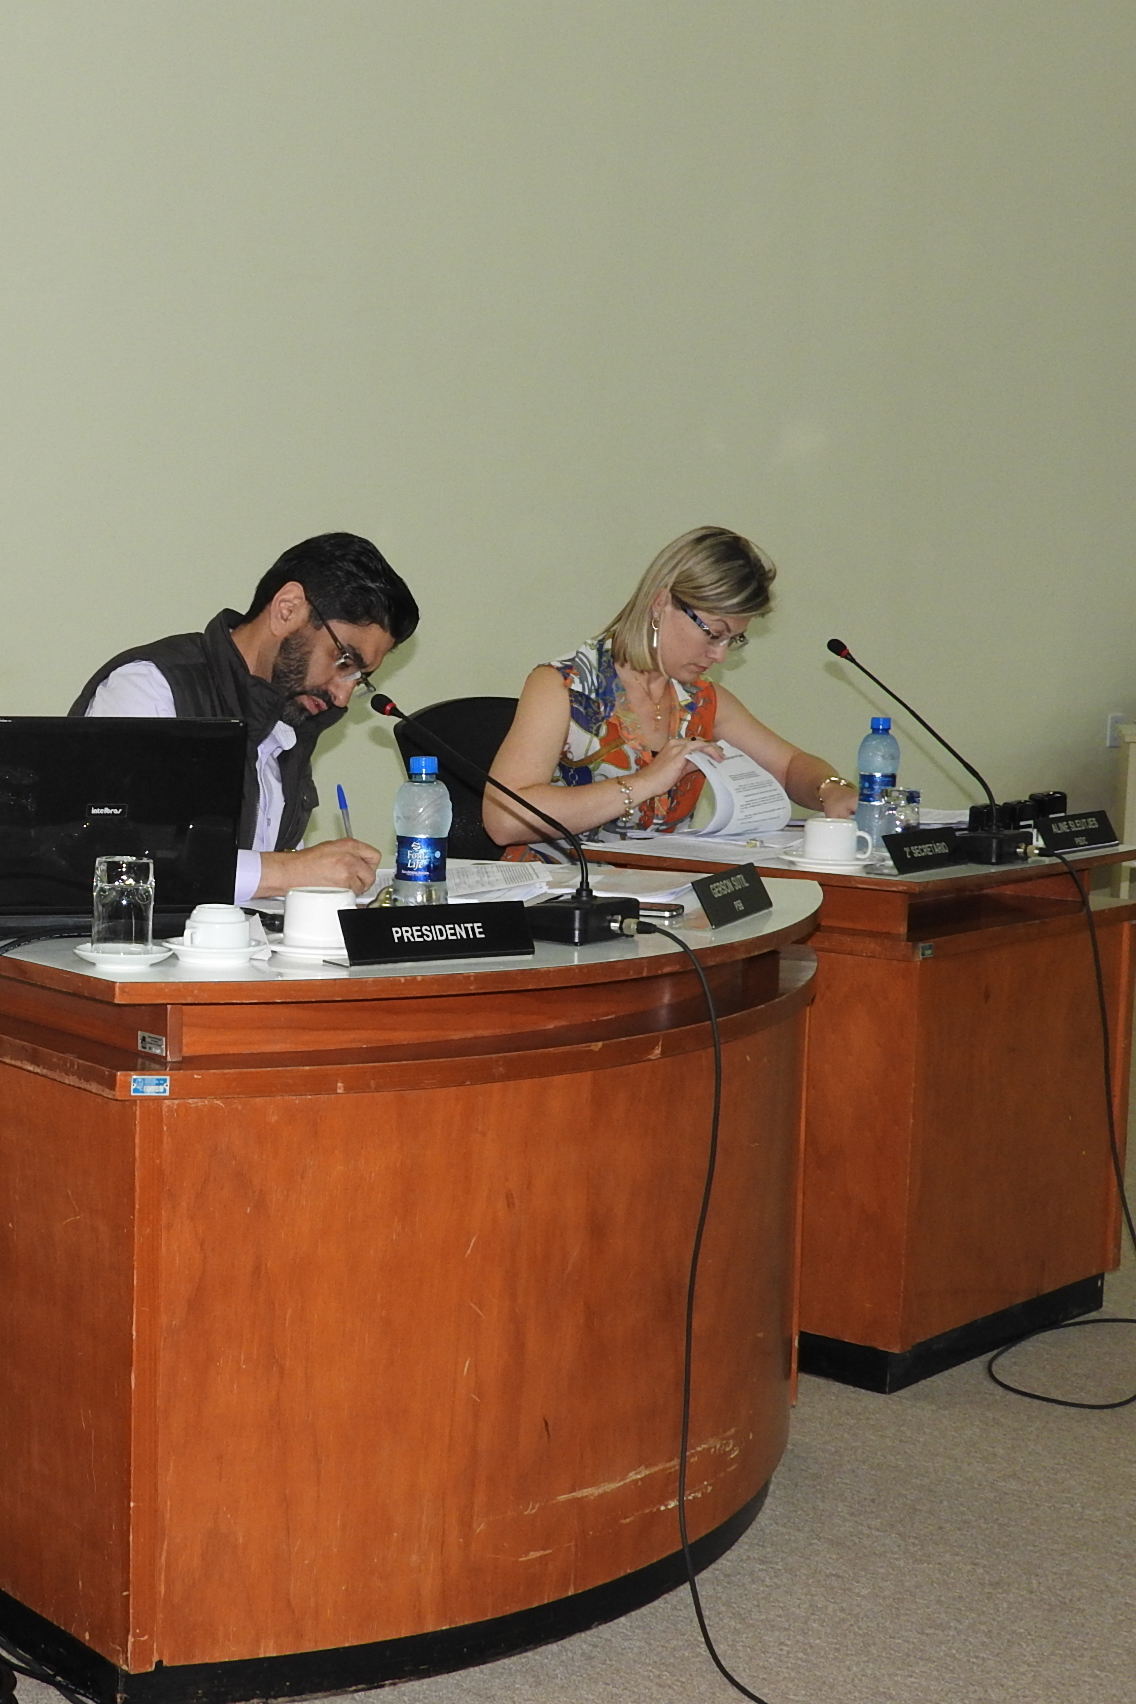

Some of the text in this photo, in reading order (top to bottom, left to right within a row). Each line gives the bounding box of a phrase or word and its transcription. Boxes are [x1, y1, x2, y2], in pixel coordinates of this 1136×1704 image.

[407, 860, 424, 870] Life
[710, 879, 734, 898] GERSON
[391, 922, 486, 943] PRESIDENTE
